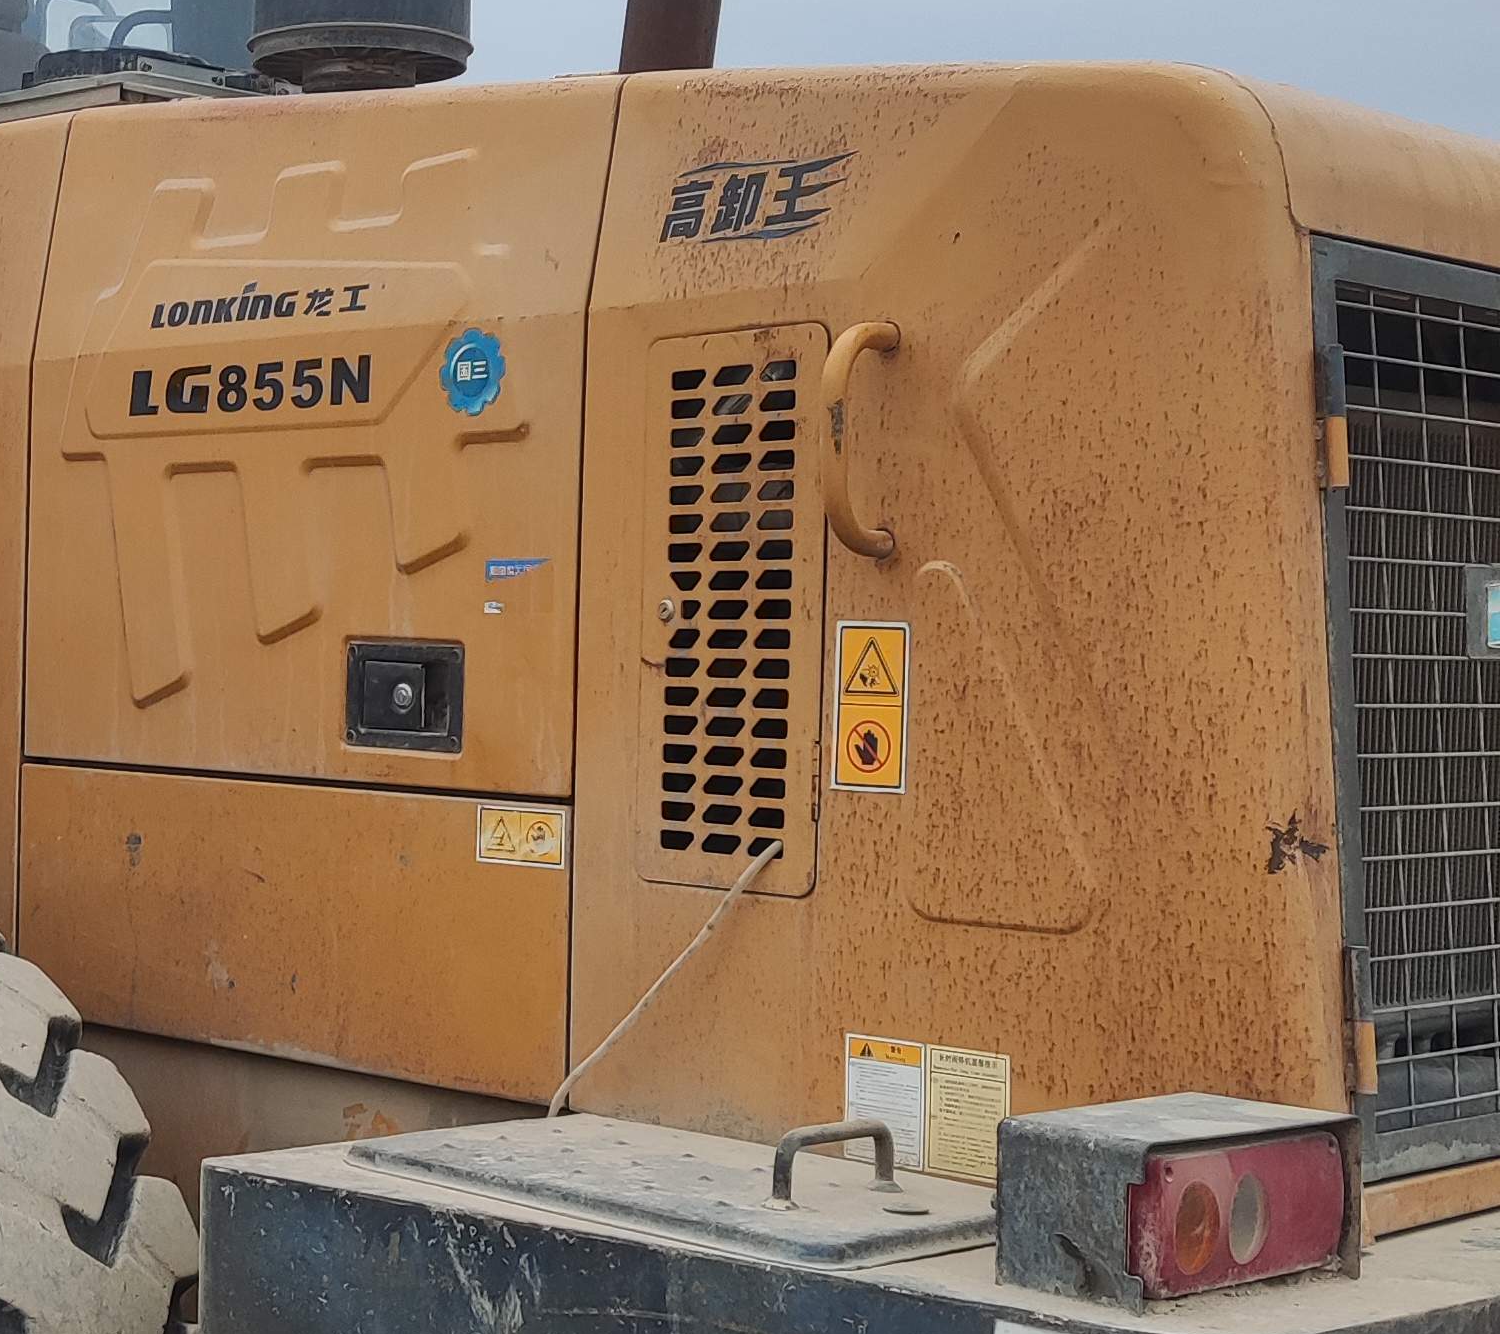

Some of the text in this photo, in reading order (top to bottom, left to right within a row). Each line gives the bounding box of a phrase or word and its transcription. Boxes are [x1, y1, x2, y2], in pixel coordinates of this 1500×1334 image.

[659, 150, 860, 244] 高卸王
[128, 354, 373, 417] LG855N
